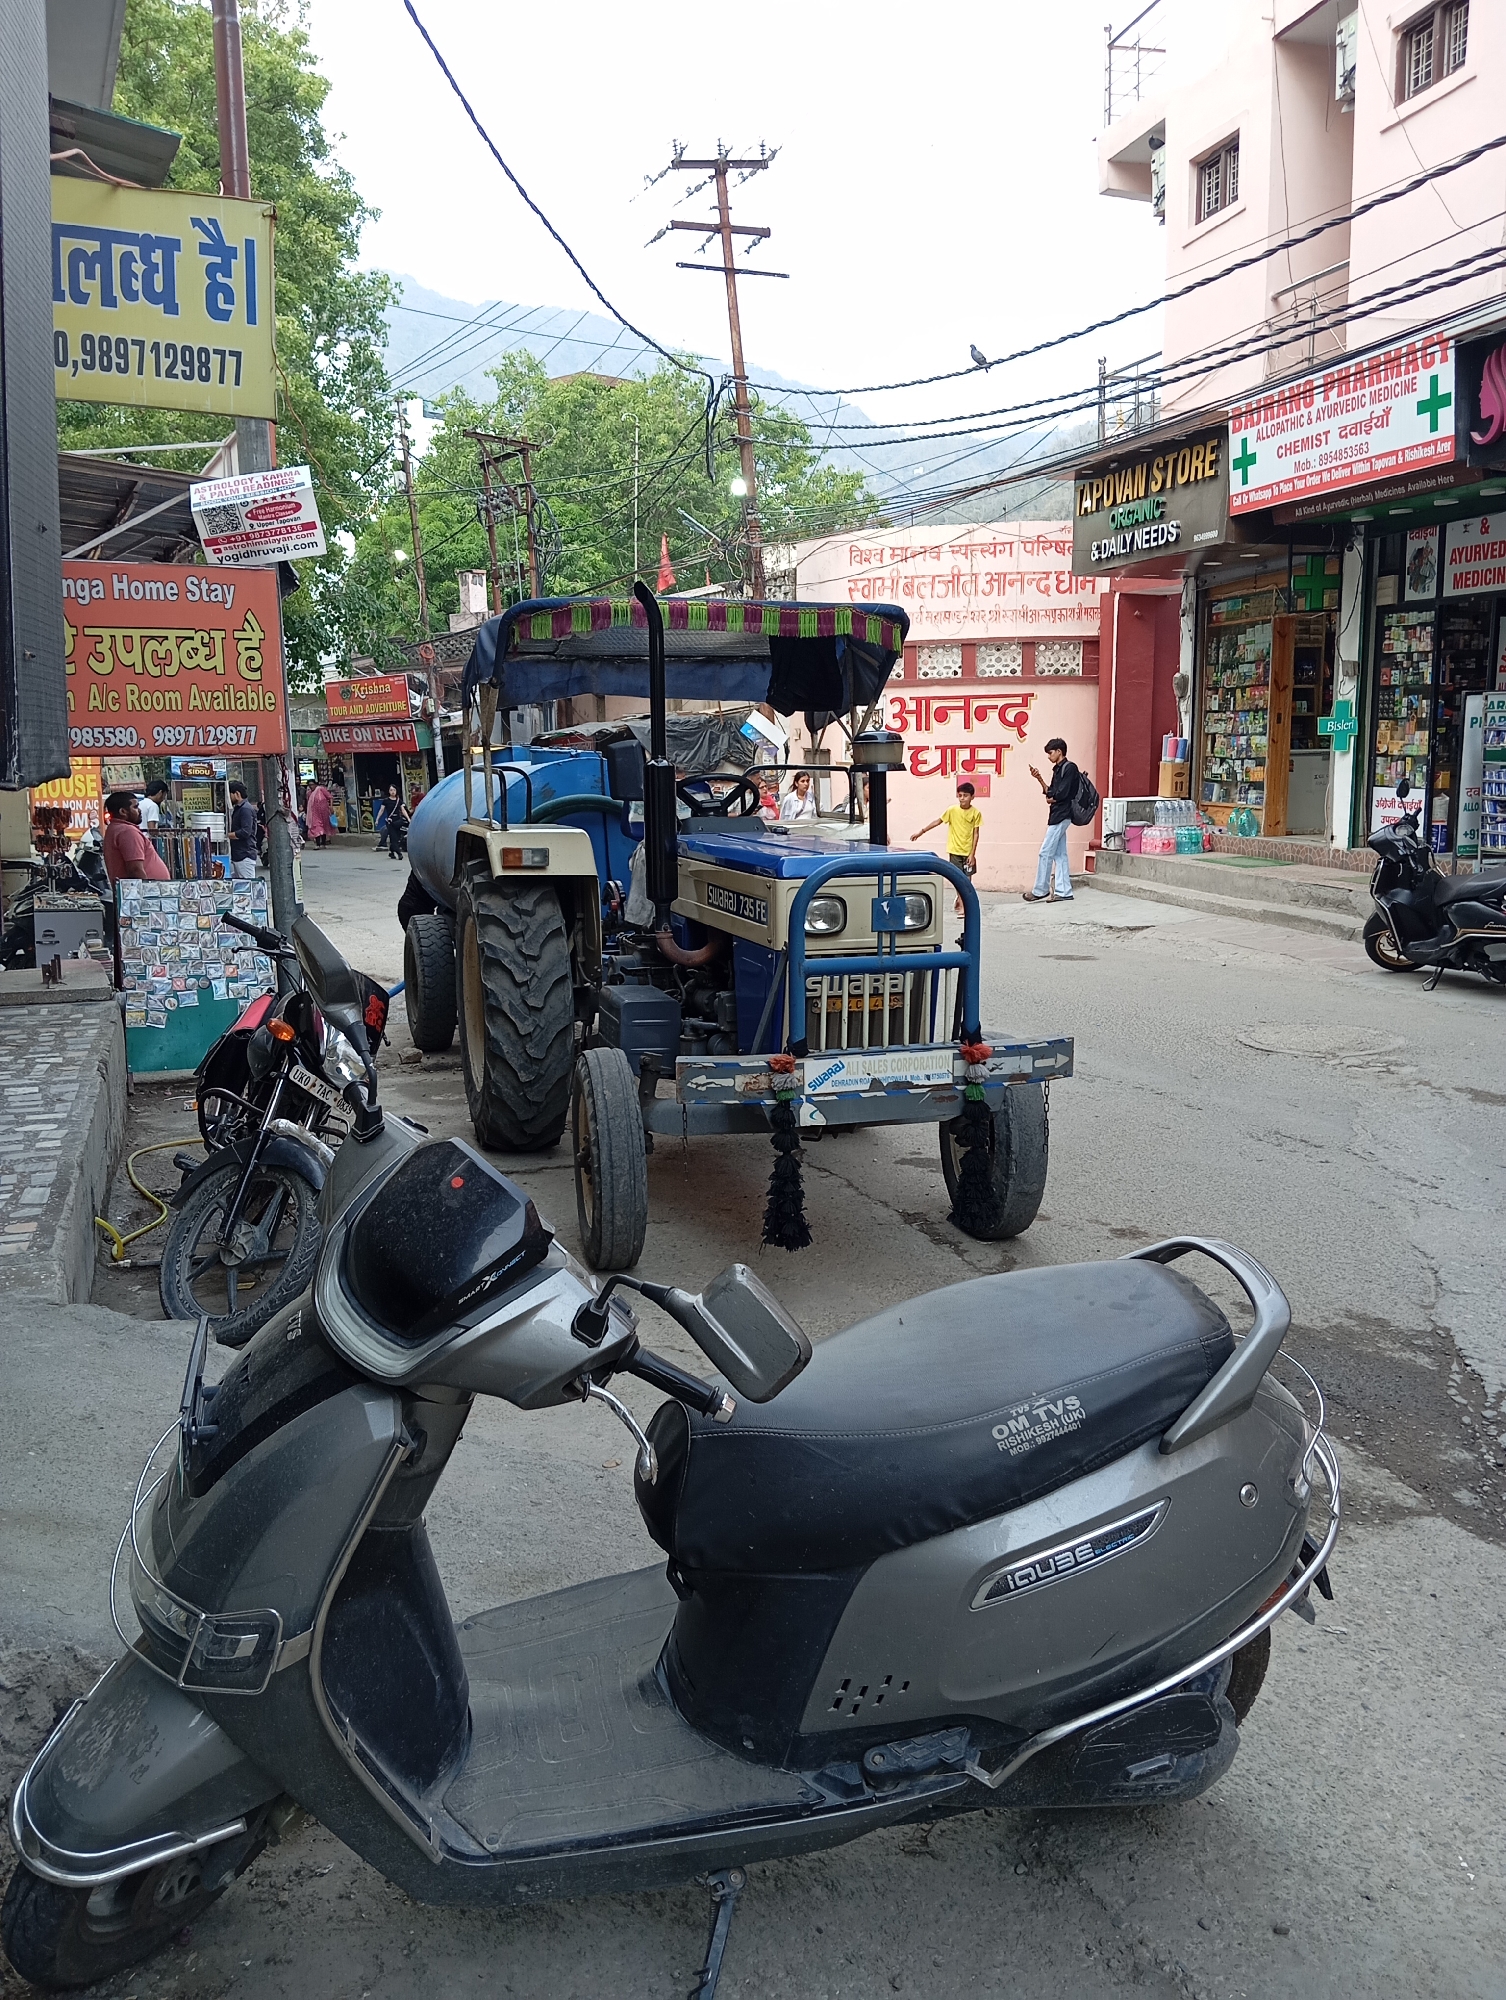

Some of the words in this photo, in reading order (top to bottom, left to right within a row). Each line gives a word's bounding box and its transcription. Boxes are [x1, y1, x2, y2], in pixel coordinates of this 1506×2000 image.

[1322, 331, 1451, 402] PHARMACY
[1256, 413, 1304, 443] ALLOPATHIC
[1306, 411, 1313, 425] &
[1316, 392, 1367, 424] AYURVEDIC
[1369, 376, 1417, 406] MEDICINE
[1276, 430, 1331, 459] CHEMIST
[1318, 441, 1370, 467] 8954853563
[262, 469, 301, 481] KARMA
[1075, 463, 1147, 516] TAPOVAN
[1151, 439, 1219, 493] STORE
[1232, 496, 1241, 507] Call
[1242, 494, 1248, 504] Or
[1249, 488, 1272, 503] Whatsapp
[1273, 486, 1278, 495] To
[1279, 481, 1292, 494] Place
[1294, 478, 1305, 490] Your
[1306, 474, 1320, 487] Order
[1322, 472, 1330, 482] We
[1331, 466, 1350, 480] Deliver
[1352, 460, 1370, 475] Within
[1371, 455, 1396, 472] Tapovan
[1397, 451, 1403, 463] &
[1404, 444, 1435, 462] Rishikesh
[199, 493, 207, 501] &
[210, 488, 239, 499] PALM
[242, 477, 295, 493] READINGS
[1303, 505, 1315, 515] Kind
[1316, 503, 1322, 512] of
[1322, 497, 1349, 513] Ayurvedic
[1375, 486, 1406, 499] Medicines
[1407, 478, 1436, 492] Available
[1437, 474, 1455, 486] Here
[253, 507, 264, 516] Free
[266, 503, 296, 514] Harmonium
[258, 512, 275, 520] Mantra
[276, 510, 294, 518] Classes
[1109, 497, 1165, 530] ORGANIC
[230, 533, 246, 542] +91
[250, 525, 303, 539] 9873778136
[256, 520, 275, 529] Upper
[275, 516, 301, 526] Tapovan
[1480, 517, 1490, 535] &
[223, 531, 315, 551] astrohimalayan.com
[1102, 530, 1134, 559] DAILY
[1134, 520, 1179, 550] NEEDS
[217, 540, 318, 564] yogidhruvaji.com
[112, 573, 179, 601] Home
[185, 576, 235, 609] Stay
[84, 626, 226, 677] उपलब्ध
[233, 608, 265, 681] है
[125, 683, 182, 712] Room
[188, 683, 276, 712] Available
[351, 682, 391, 699] Krishna
[330, 705, 348, 716] TOUR
[349, 703, 364, 715] AND
[365, 700, 407, 714] ADVENTURE
[885, 693, 1036, 740] आनन्द
[153, 725, 257, 748] 9897129877
[321, 728, 351, 743] BIKE
[353, 727, 372, 742] ON
[375, 725, 412, 741] RENT
[1327, 720, 1354, 731] Bisleri
[907, 744, 1012, 777] धाम
[34, 774, 98, 798] HOUSE
[63, 800, 82, 810] NON
[85, 800, 99, 810] A/C
[740, 896, 754, 918] 735
[756, 900, 767, 922] FE
[846, 1060, 860, 1076] ALI
[862, 1057, 888, 1075] SALES
[891, 1054, 950, 1073] CORPORATION
[293, 1069, 311, 1086] UK0
[317, 1084, 332, 1100] 7AC
[831, 1078, 858, 1088] DEHRADUN
[992, 1415, 1030, 1439] OM
[1032, 1395, 1081, 1421] TVS
[1010, 1403, 1029, 1417] TVS
[996, 1419, 1059, 1451] RISHIKESH
[1061, 1407, 1086, 1425] (UK)
[1009, 1442, 1036, 1456] MOB.:
[1036, 1421, 1081, 1445] 9927444401
[1095, 1533, 1135, 1555] ELECTRIC
